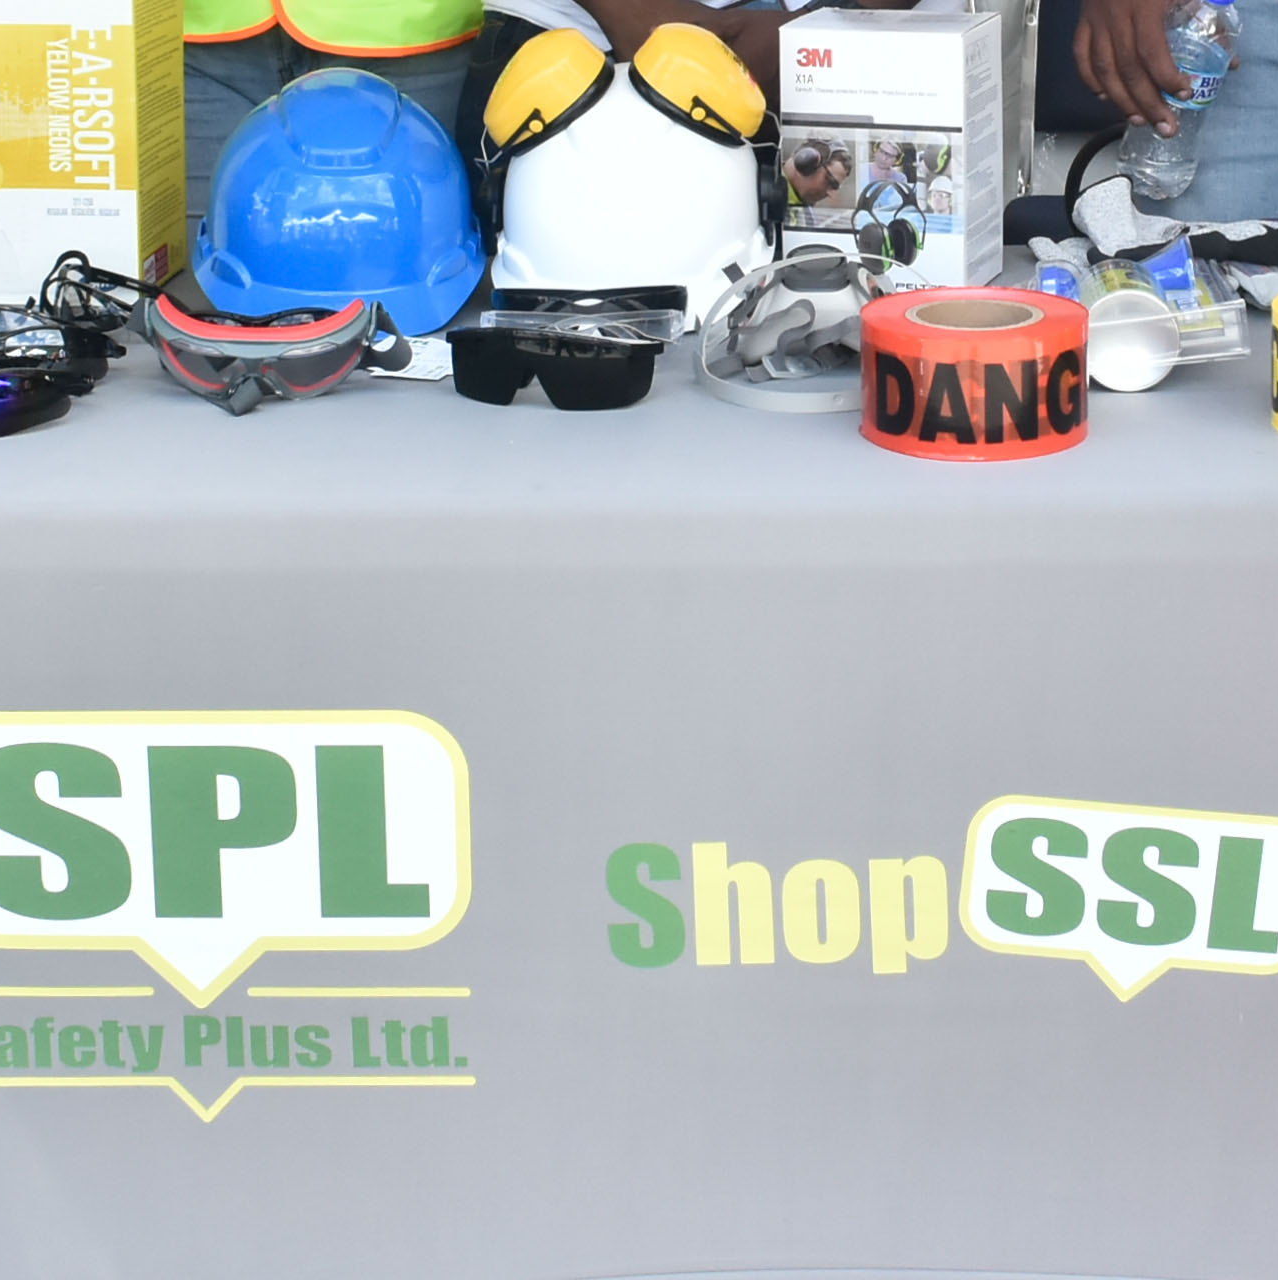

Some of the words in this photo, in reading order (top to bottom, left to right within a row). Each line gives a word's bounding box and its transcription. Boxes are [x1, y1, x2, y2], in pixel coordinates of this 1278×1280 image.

[46, 38, 71, 109] YELLOW
[795, 73, 814, 84] X1A
[796, 47, 832, 68] 3M
[48, 114, 73, 173] NEONS
[876, 349, 1082, 445] DANG
[183, 1015, 333, 1069] Plus
[351, 1015, 468, 1069] Ltd.
